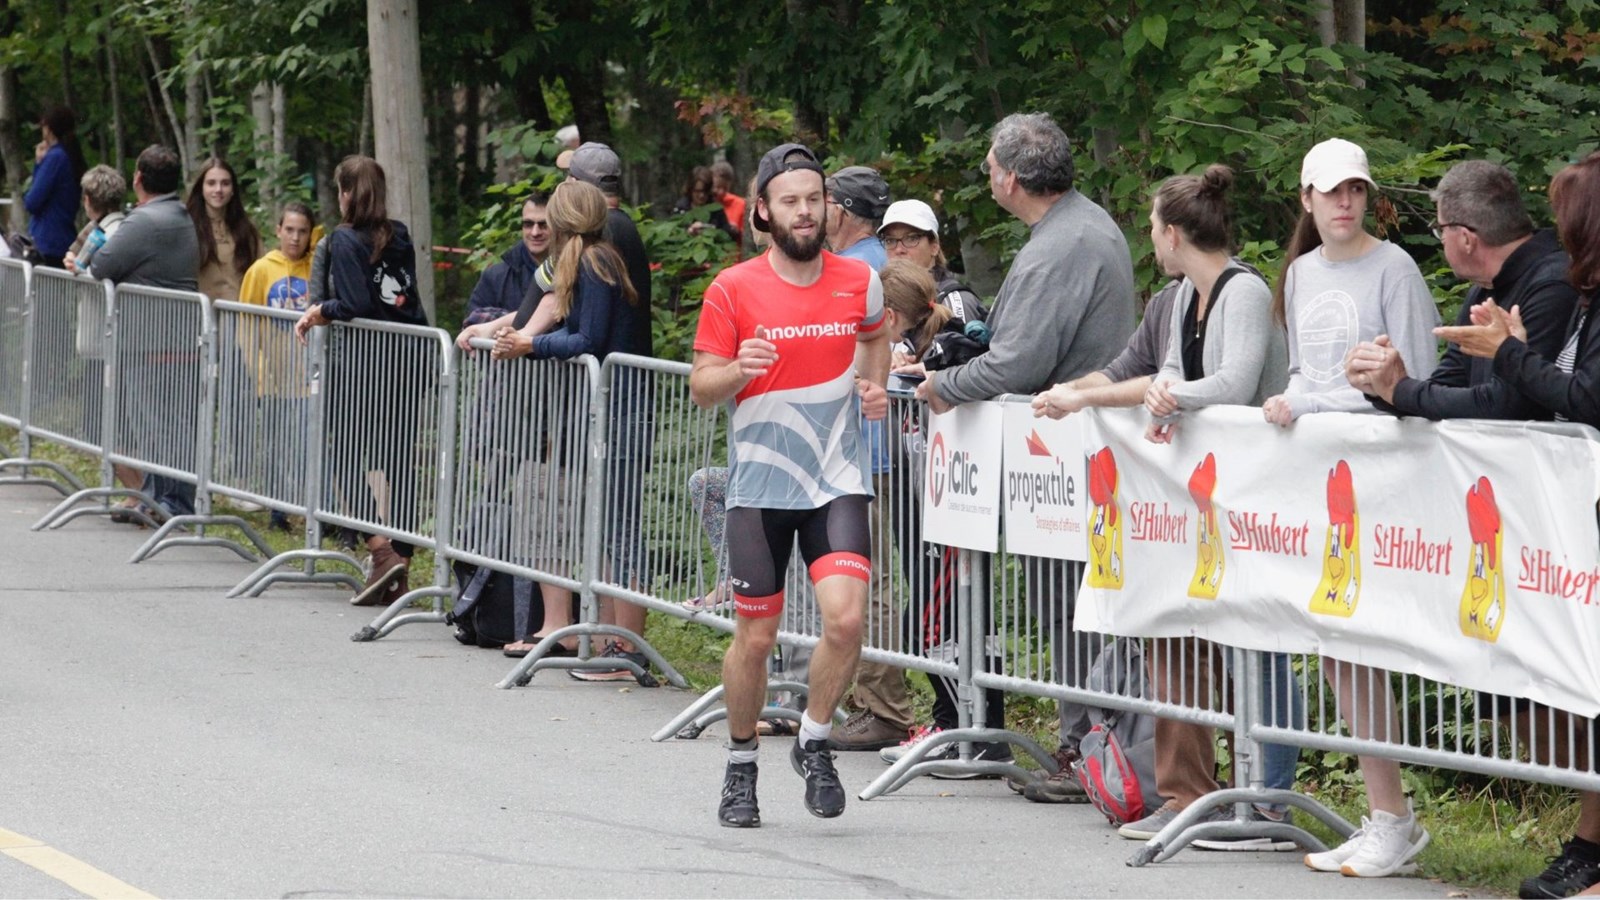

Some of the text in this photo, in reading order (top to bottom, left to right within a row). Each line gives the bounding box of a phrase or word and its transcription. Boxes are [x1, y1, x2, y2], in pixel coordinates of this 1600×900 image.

[270, 297, 310, 310] NAS
[948, 450, 978, 496] iClic
[1008, 456, 1075, 513] projektile
